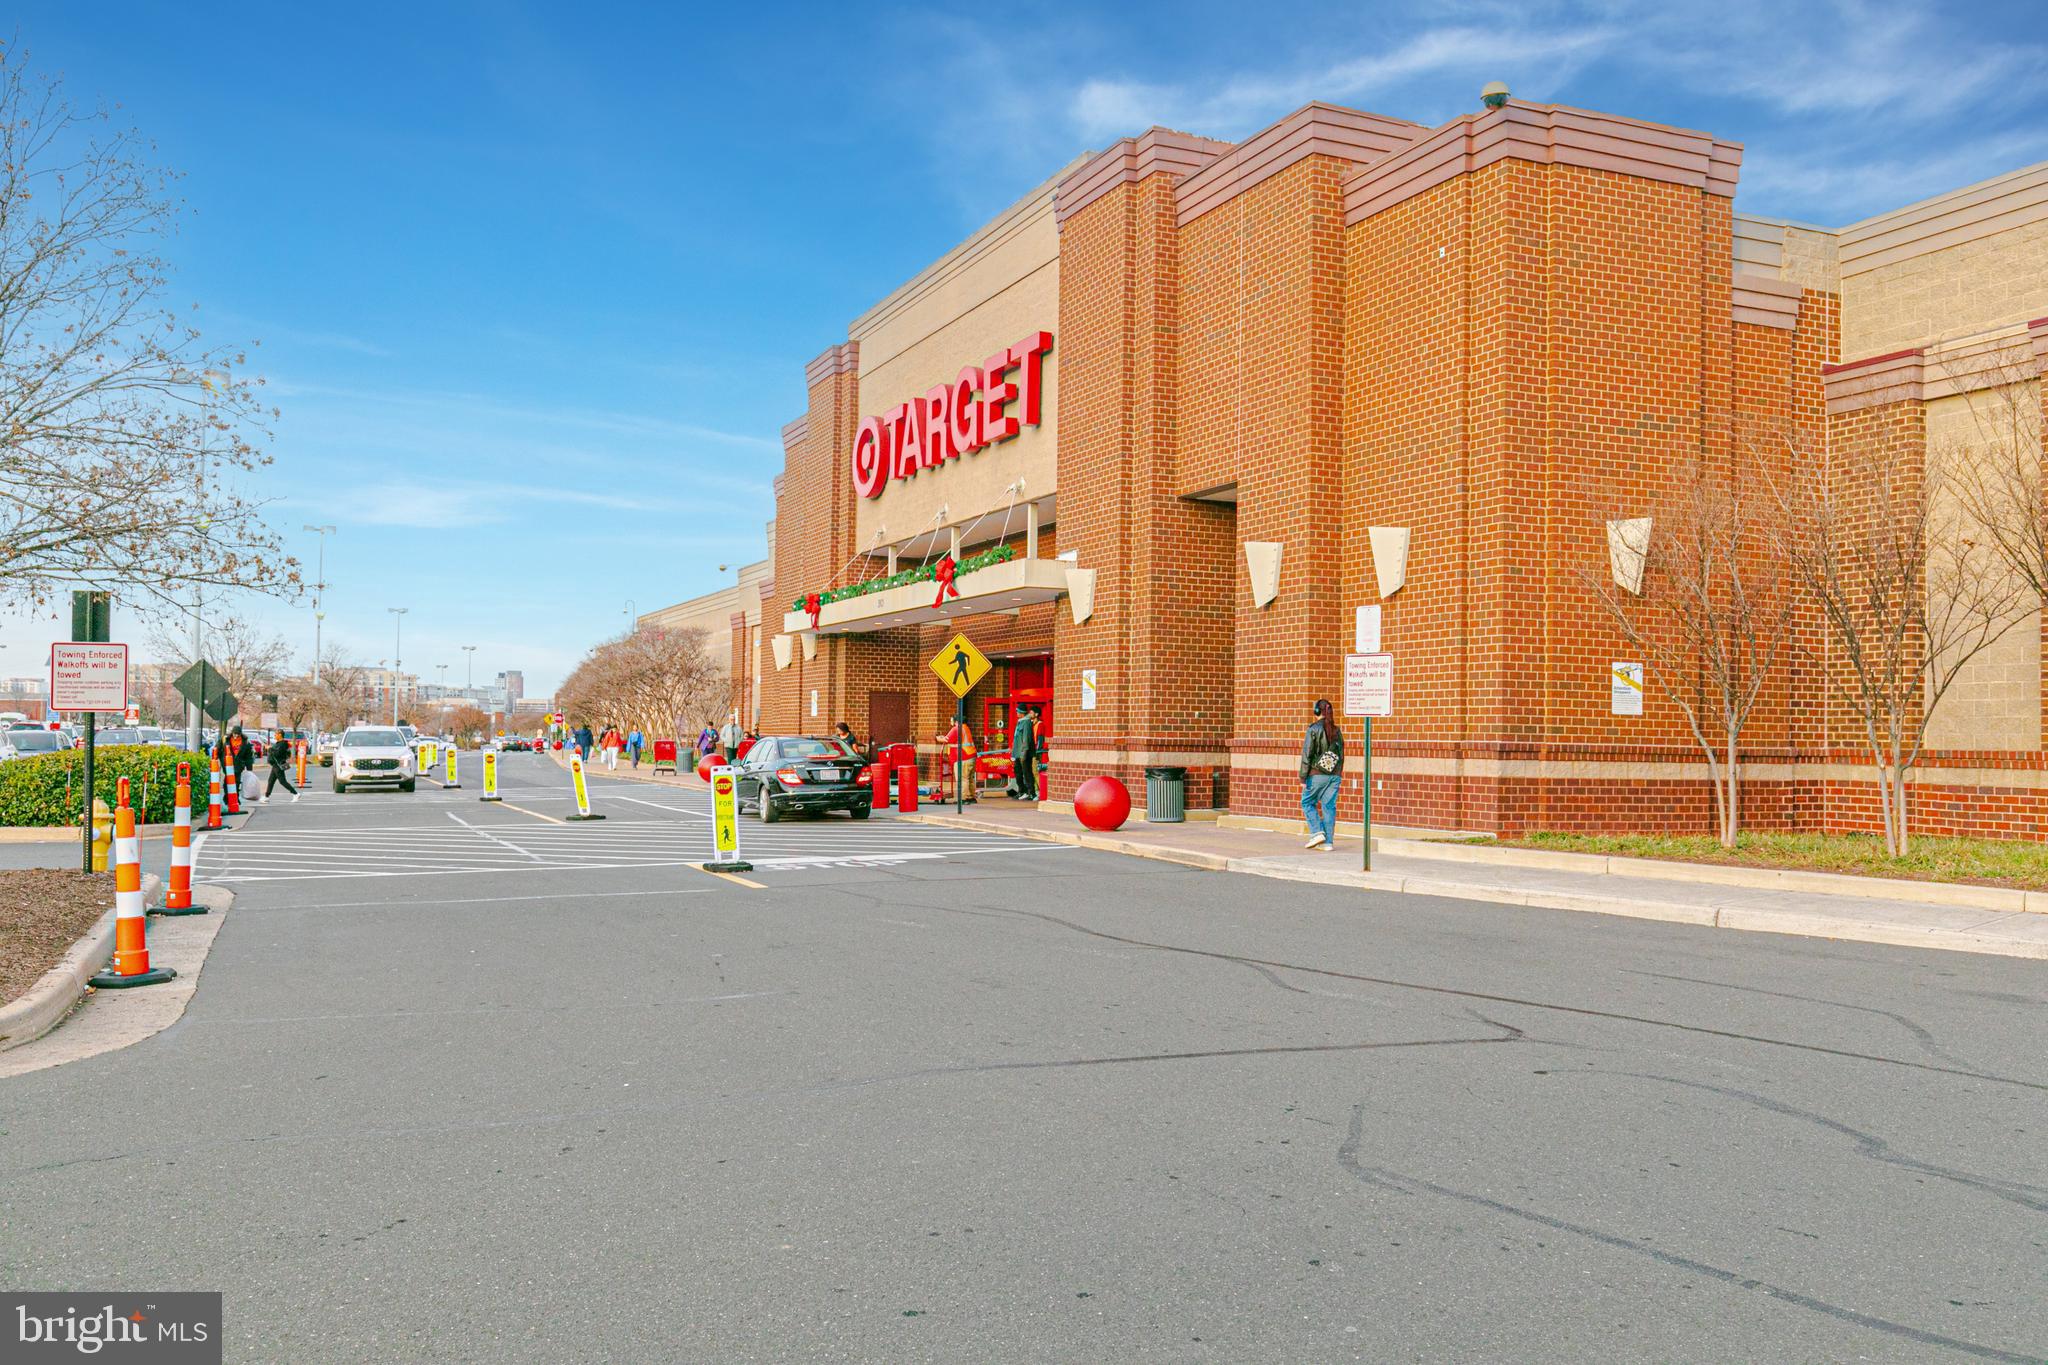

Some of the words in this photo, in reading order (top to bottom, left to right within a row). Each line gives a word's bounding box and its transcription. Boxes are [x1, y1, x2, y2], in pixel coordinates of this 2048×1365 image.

[884, 331, 1053, 480] TARGET
[58, 650, 86, 659] Towing
[88, 650, 123, 659] Enforced
[57, 661, 89, 669] Walkoffs
[92, 661, 106, 669] will
[108, 661, 118, 669] be
[1349, 661, 1366, 669] Towing
[1367, 661, 1389, 669] Enforced
[57, 671, 81, 679] towed
